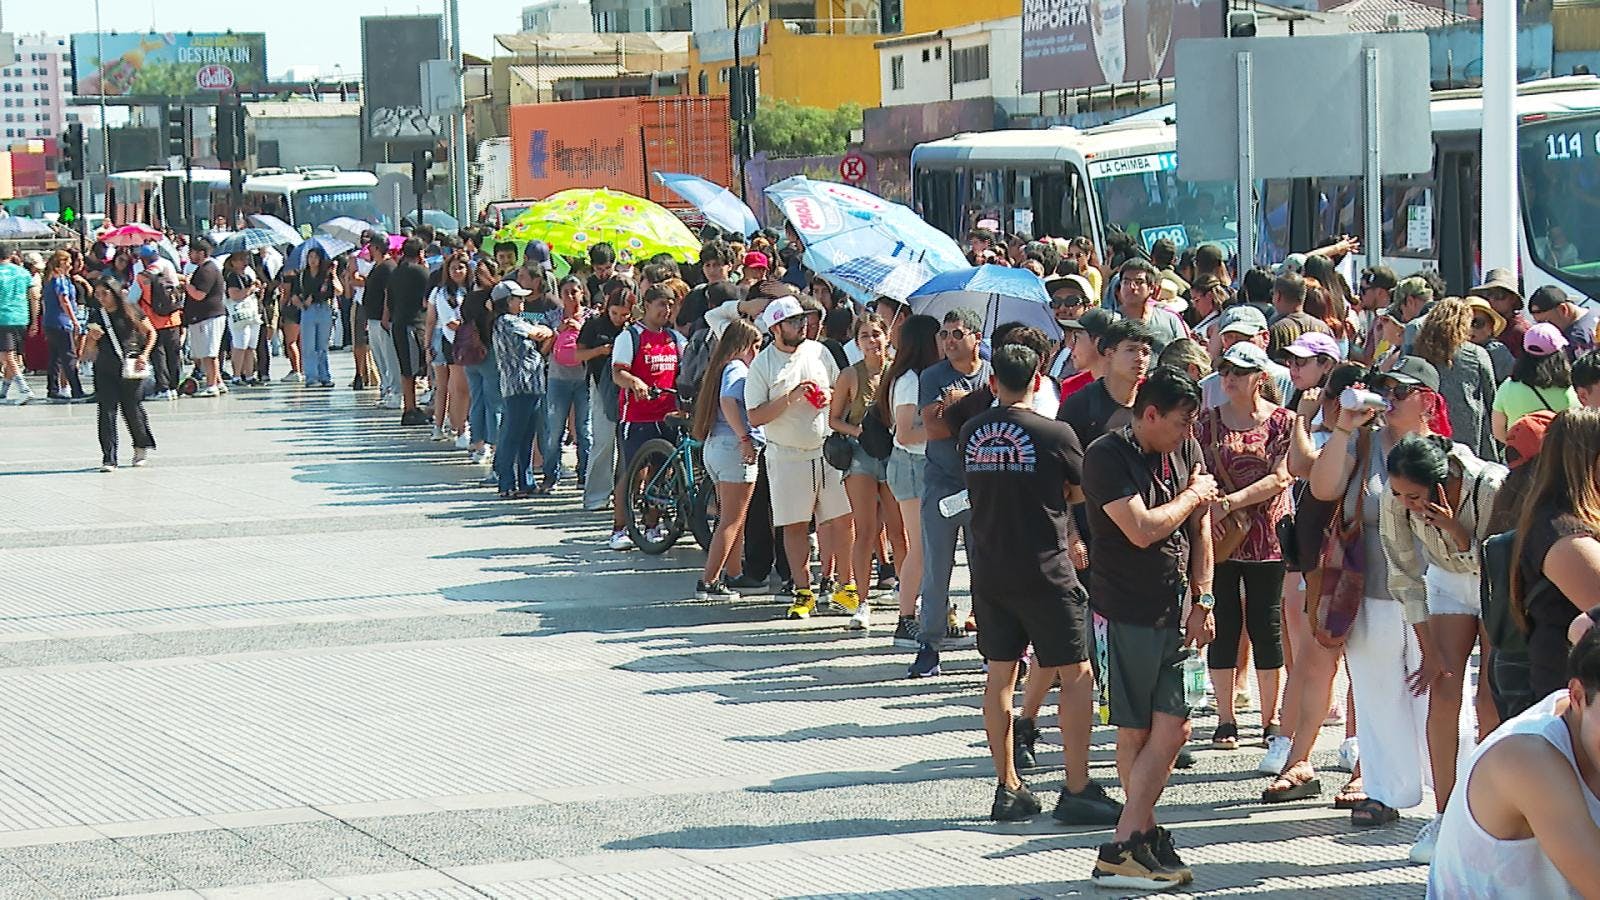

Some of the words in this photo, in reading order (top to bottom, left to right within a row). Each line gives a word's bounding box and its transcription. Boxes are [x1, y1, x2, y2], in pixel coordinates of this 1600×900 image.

[1024, 5, 1087, 32] IMPORTA
[178, 47, 231, 63] DESTAPA
[233, 47, 250, 63] UN
[1546, 131, 1581, 159] 114
[1100, 162, 1112, 174] LA
[1114, 158, 1151, 172] CHIMBA
[644, 353, 678, 364] Emirates
